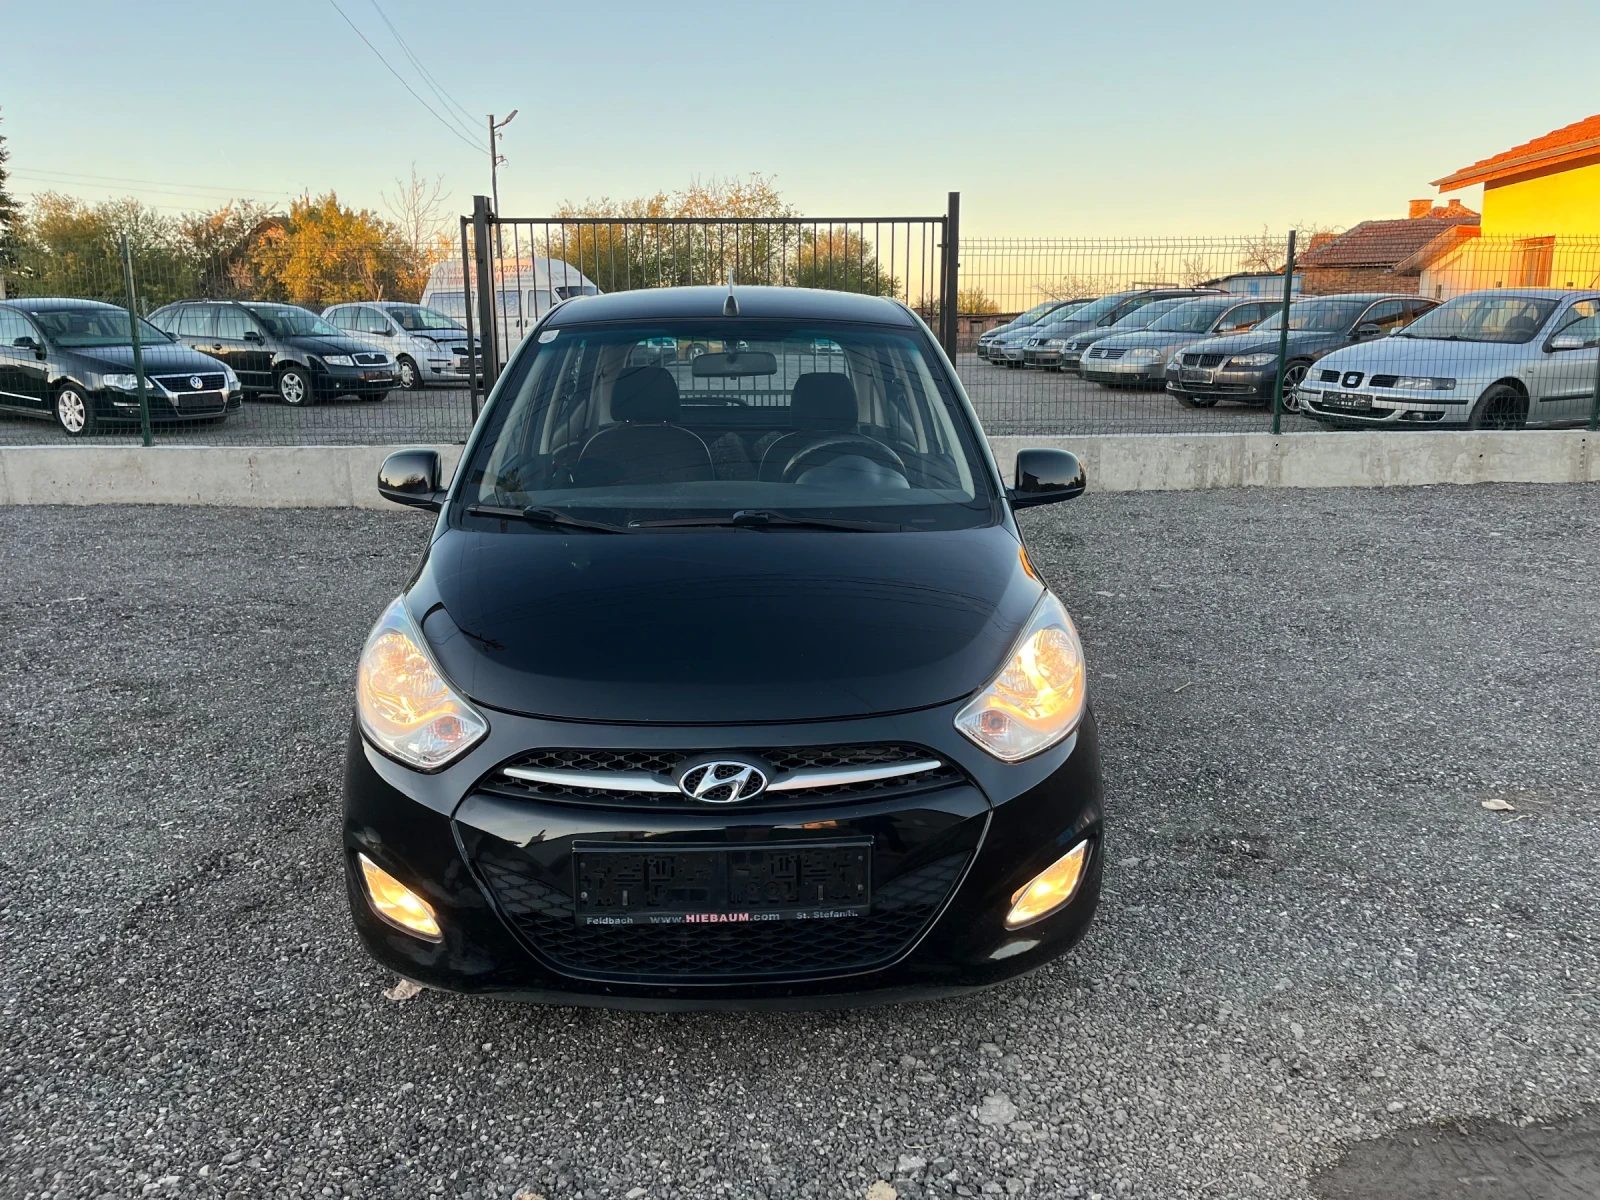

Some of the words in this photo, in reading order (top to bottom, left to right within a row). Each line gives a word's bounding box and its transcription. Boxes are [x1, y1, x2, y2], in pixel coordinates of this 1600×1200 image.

[586, 916, 634, 925] Feldbach
[650, 912, 781, 924] www.HIEBAUM.com
[796, 911, 811, 920] St.
